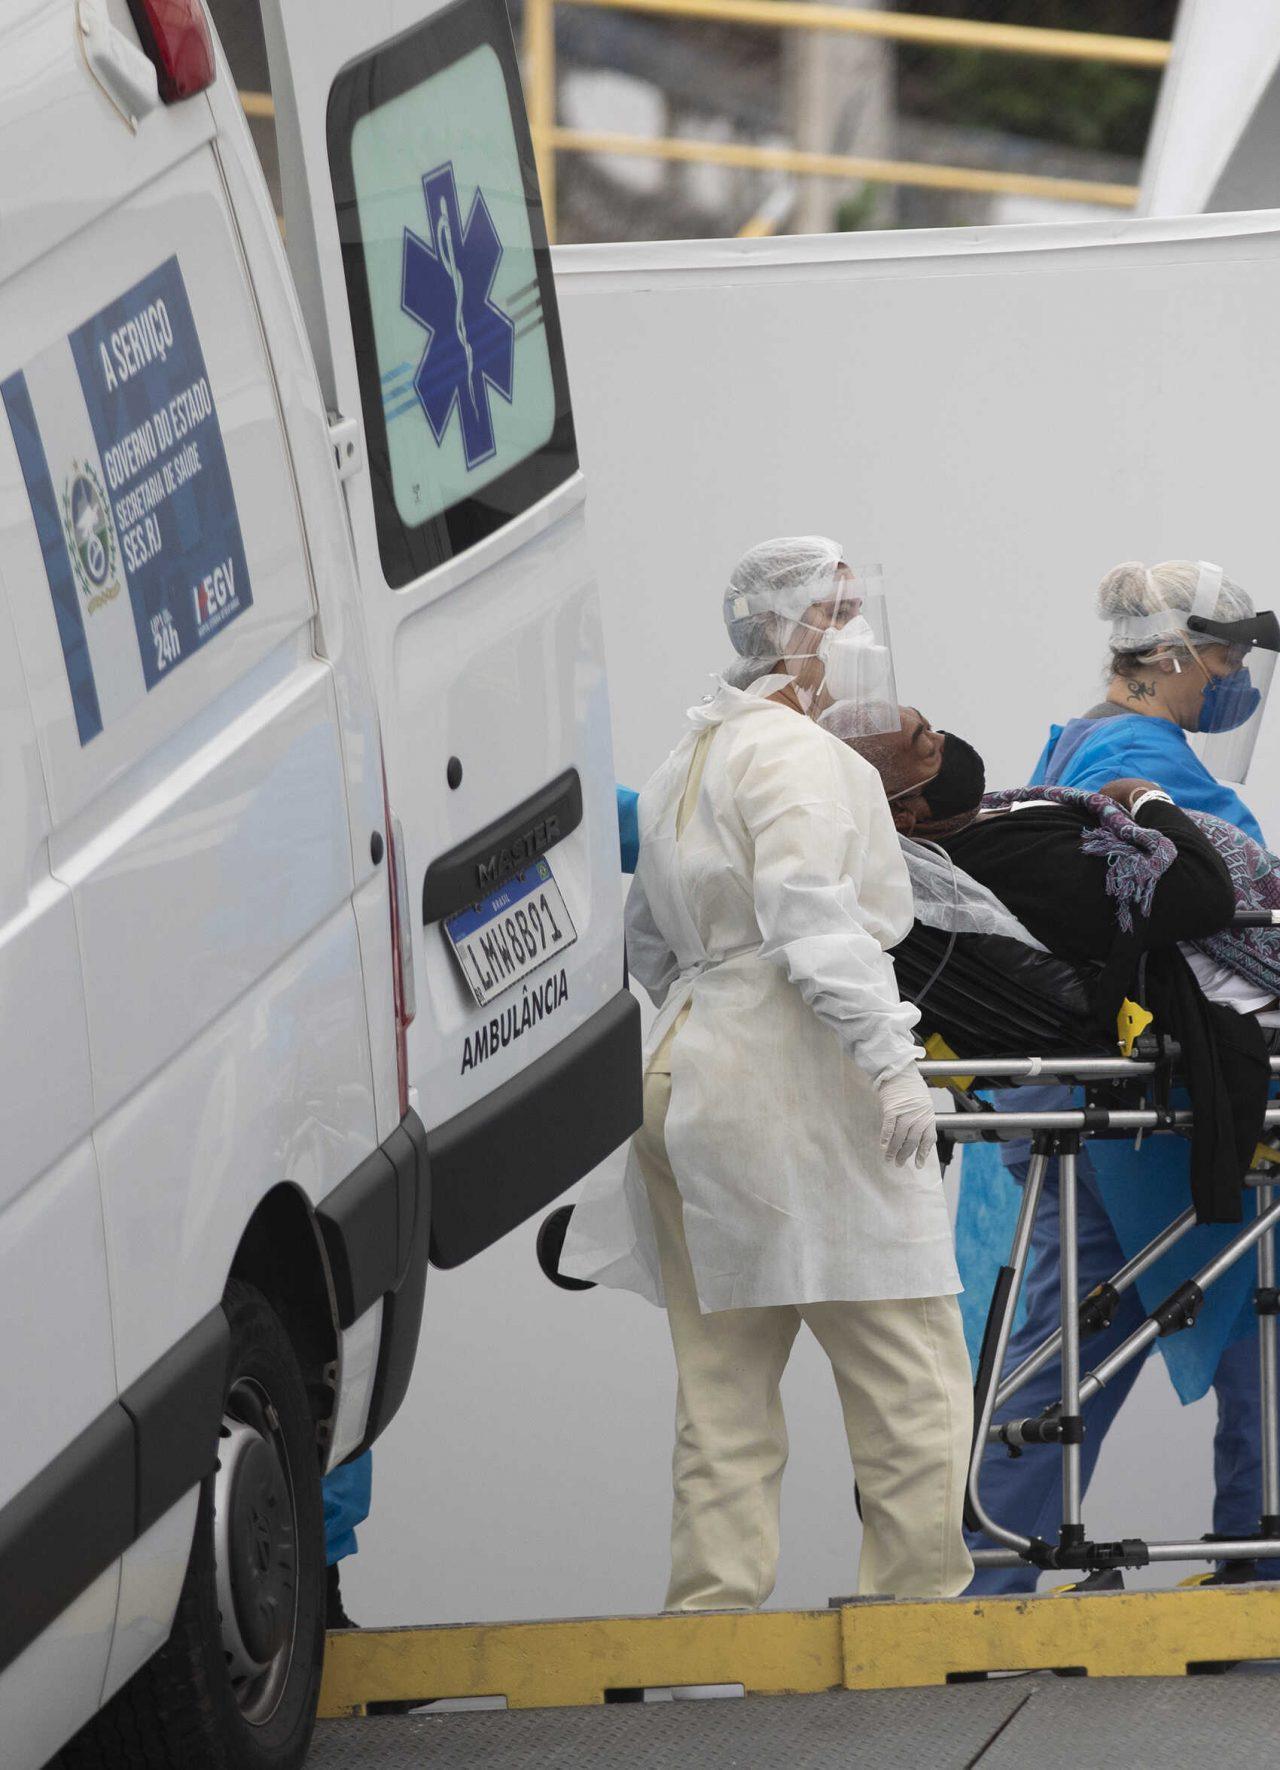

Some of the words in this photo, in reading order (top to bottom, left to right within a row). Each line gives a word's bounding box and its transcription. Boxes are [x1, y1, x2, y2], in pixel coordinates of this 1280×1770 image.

[100, 341, 118, 393] A
[111, 298, 174, 383] SERVIÇO
[104, 420, 158, 490] GOVERNO
[153, 408, 174, 451] DO
[169, 377, 213, 440] ESTADO
[116, 469, 166, 532] SECRETARIA
[163, 463, 175, 496] DE
[174, 441, 202, 485] SAÚDE
[123, 512, 163, 574] SES.RJ
[477, 815, 560, 889] MASTER
[467, 893, 563, 991] LMW8B91
[460, 968, 569, 1075] AMBULÂNCIA
